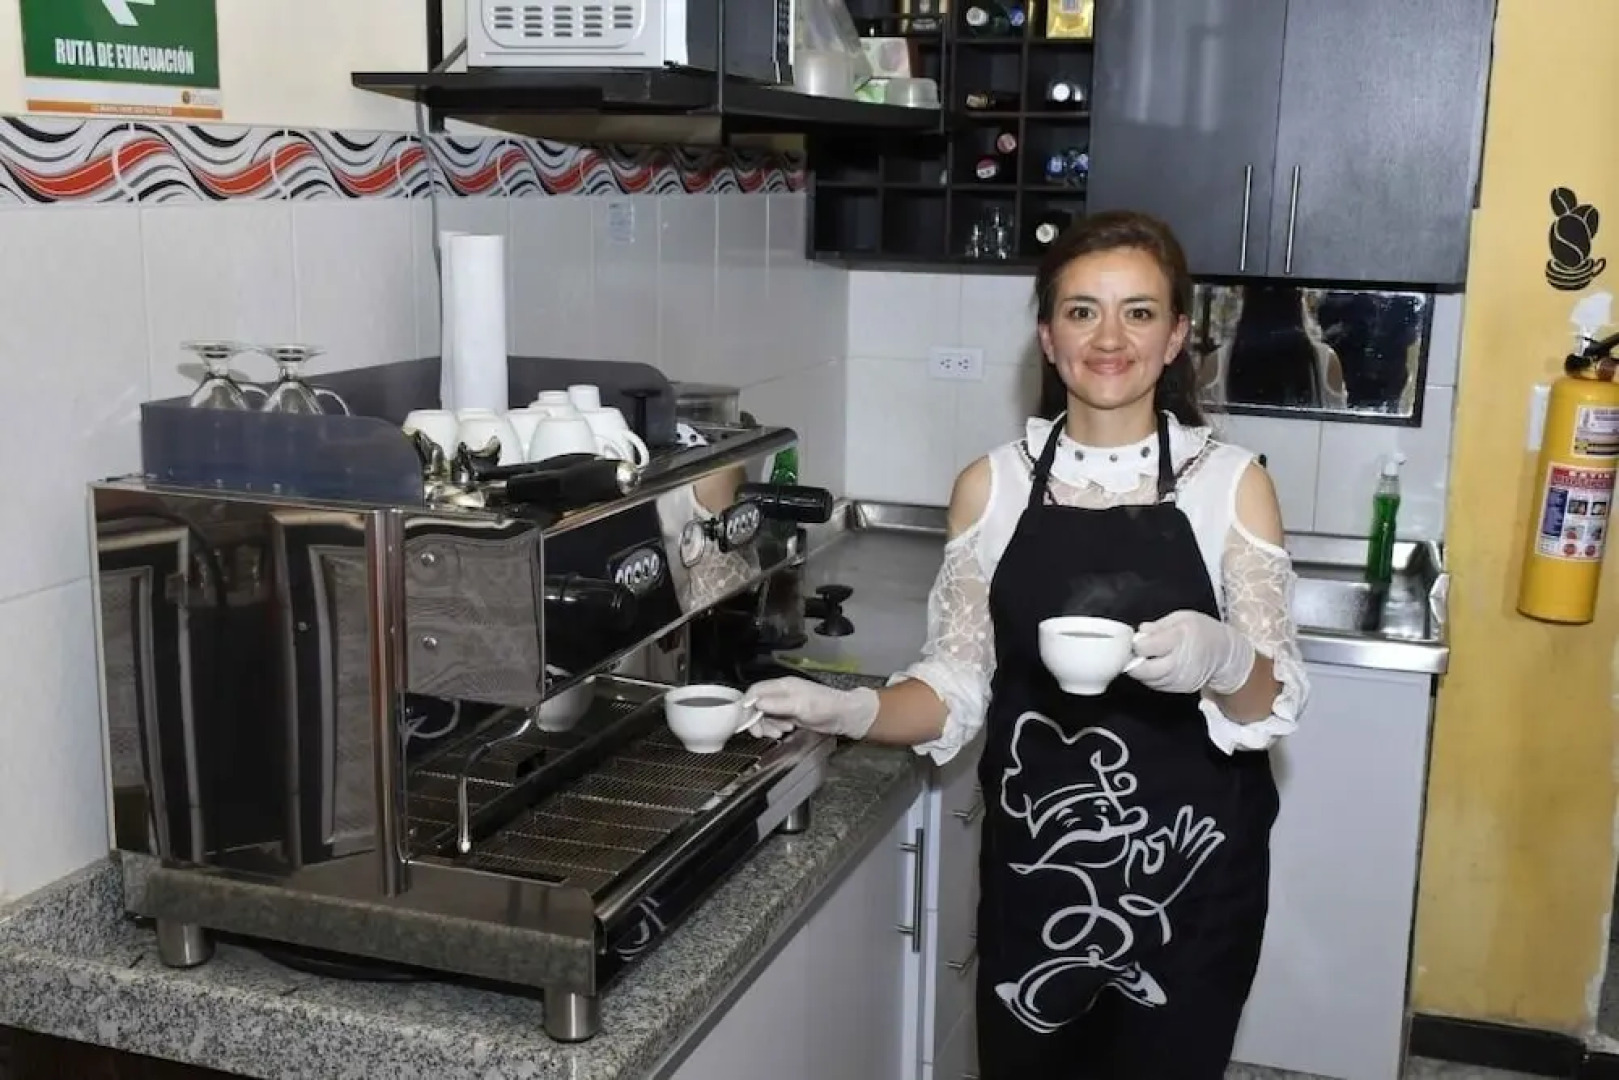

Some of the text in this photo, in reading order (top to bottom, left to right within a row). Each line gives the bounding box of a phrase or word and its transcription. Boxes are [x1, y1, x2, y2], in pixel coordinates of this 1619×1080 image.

[55, 38, 194, 75] RUTA DE EVACUACIÓN
